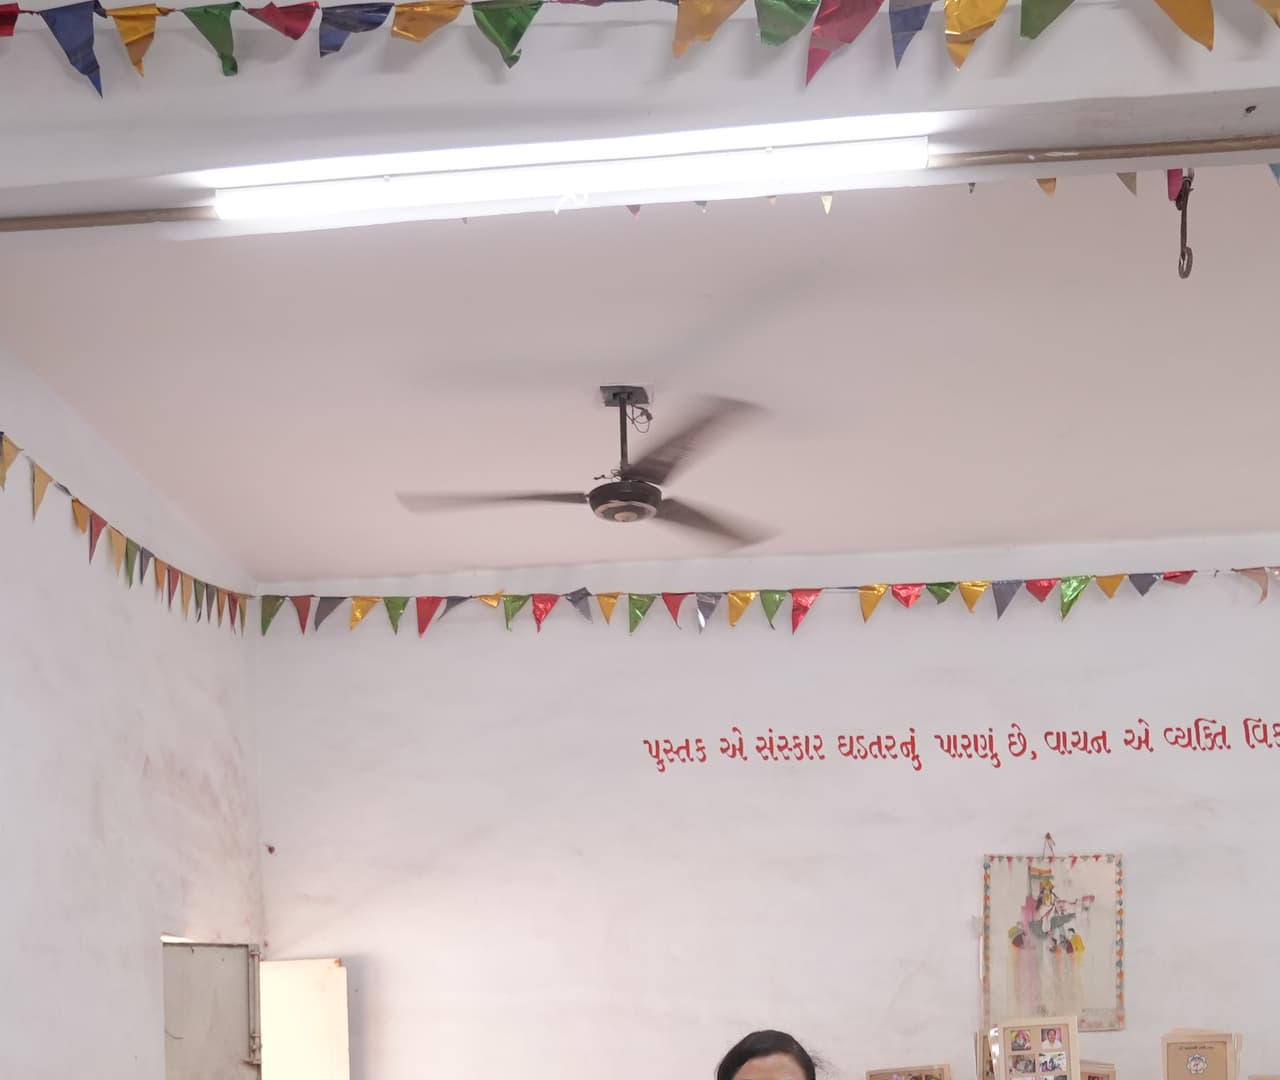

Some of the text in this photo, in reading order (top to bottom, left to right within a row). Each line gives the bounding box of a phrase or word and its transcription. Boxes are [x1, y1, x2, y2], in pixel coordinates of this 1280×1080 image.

[643, 738, 708, 773] પુસ્તક
[720, 726, 748, 761] એ
[756, 728, 826, 761] સંસ્કાર
[838, 727, 923, 772] ઘડતરનું
[935, 728, 1002, 768] પારણું
[1008, 722, 1038, 761] છે,
[1044, 730, 1112, 755] વાચન
[1124, 719, 1154, 752] એ
[1164, 717, 1231, 751] વ્યક્તિ
